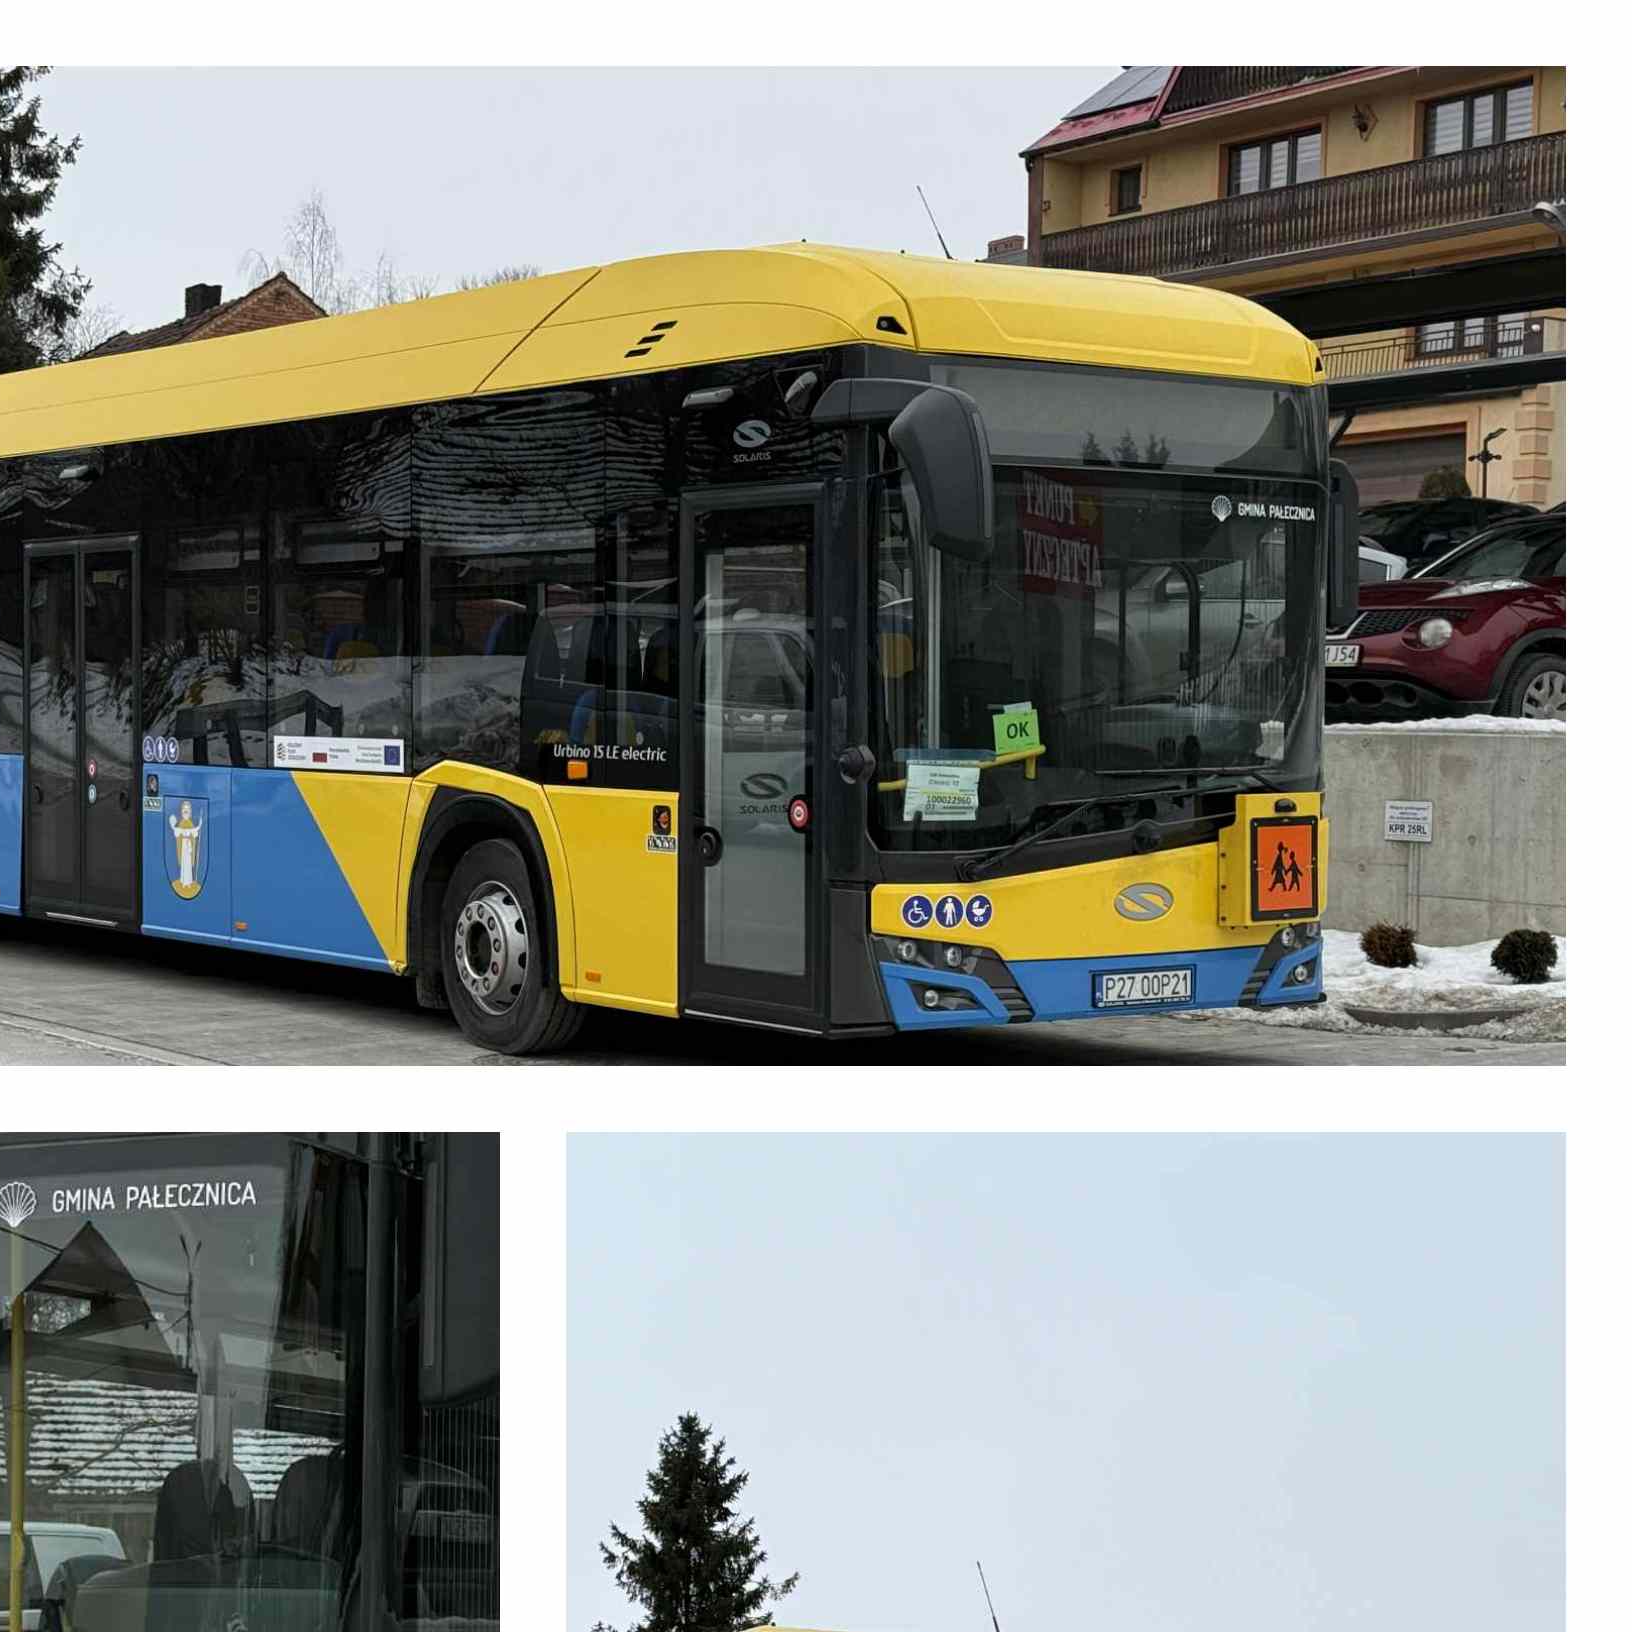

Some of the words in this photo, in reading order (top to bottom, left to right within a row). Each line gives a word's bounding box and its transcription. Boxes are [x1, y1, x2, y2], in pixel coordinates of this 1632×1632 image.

[1237, 502, 1266, 518] GMINA
[1269, 503, 1316, 522] PAŁECZNICA
[1006, 721, 1030, 739] OK
[553, 743, 591, 759] Urbino
[593, 745, 605, 760] 15
[606, 746, 619, 761] LE
[622, 747, 667, 763] electric
[1388, 823, 1406, 833] KPR
[1105, 976, 1136, 1000] P27
[1141, 972, 1189, 997] 00P21
[51, 1184, 116, 1214] GMINA
[125, 1180, 258, 1211] PAŁECZNICA
